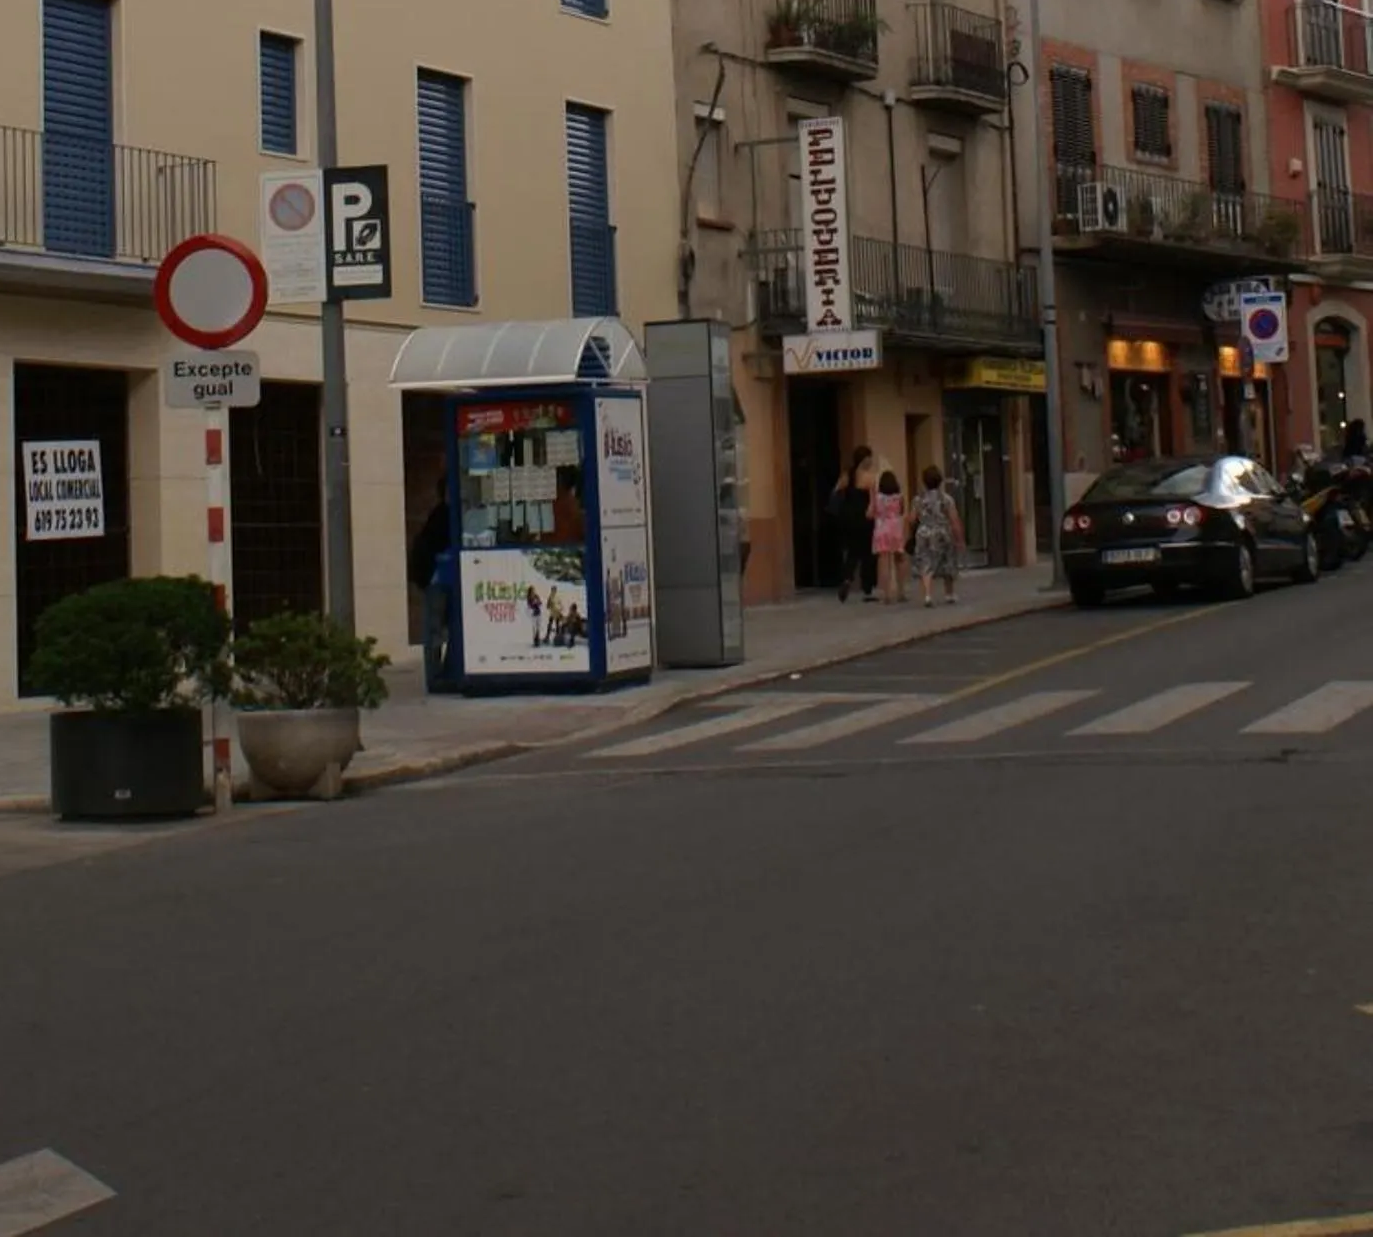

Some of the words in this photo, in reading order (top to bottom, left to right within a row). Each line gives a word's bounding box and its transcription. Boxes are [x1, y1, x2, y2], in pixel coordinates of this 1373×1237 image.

[332, 182, 372, 251] P
[174, 361, 253, 380] Excepte
[193, 380, 233, 399] gual
[31, 450, 47, 475] ES
[53, 449, 96, 474] LLOGA
[29, 479, 54, 502] LOCAL
[56, 478, 101, 501] COMERCIAL
[34, 508, 52, 532] 619
[54, 508, 67, 531] 75
[69, 507, 84, 531] 23
[85, 507, 99, 529] 93
